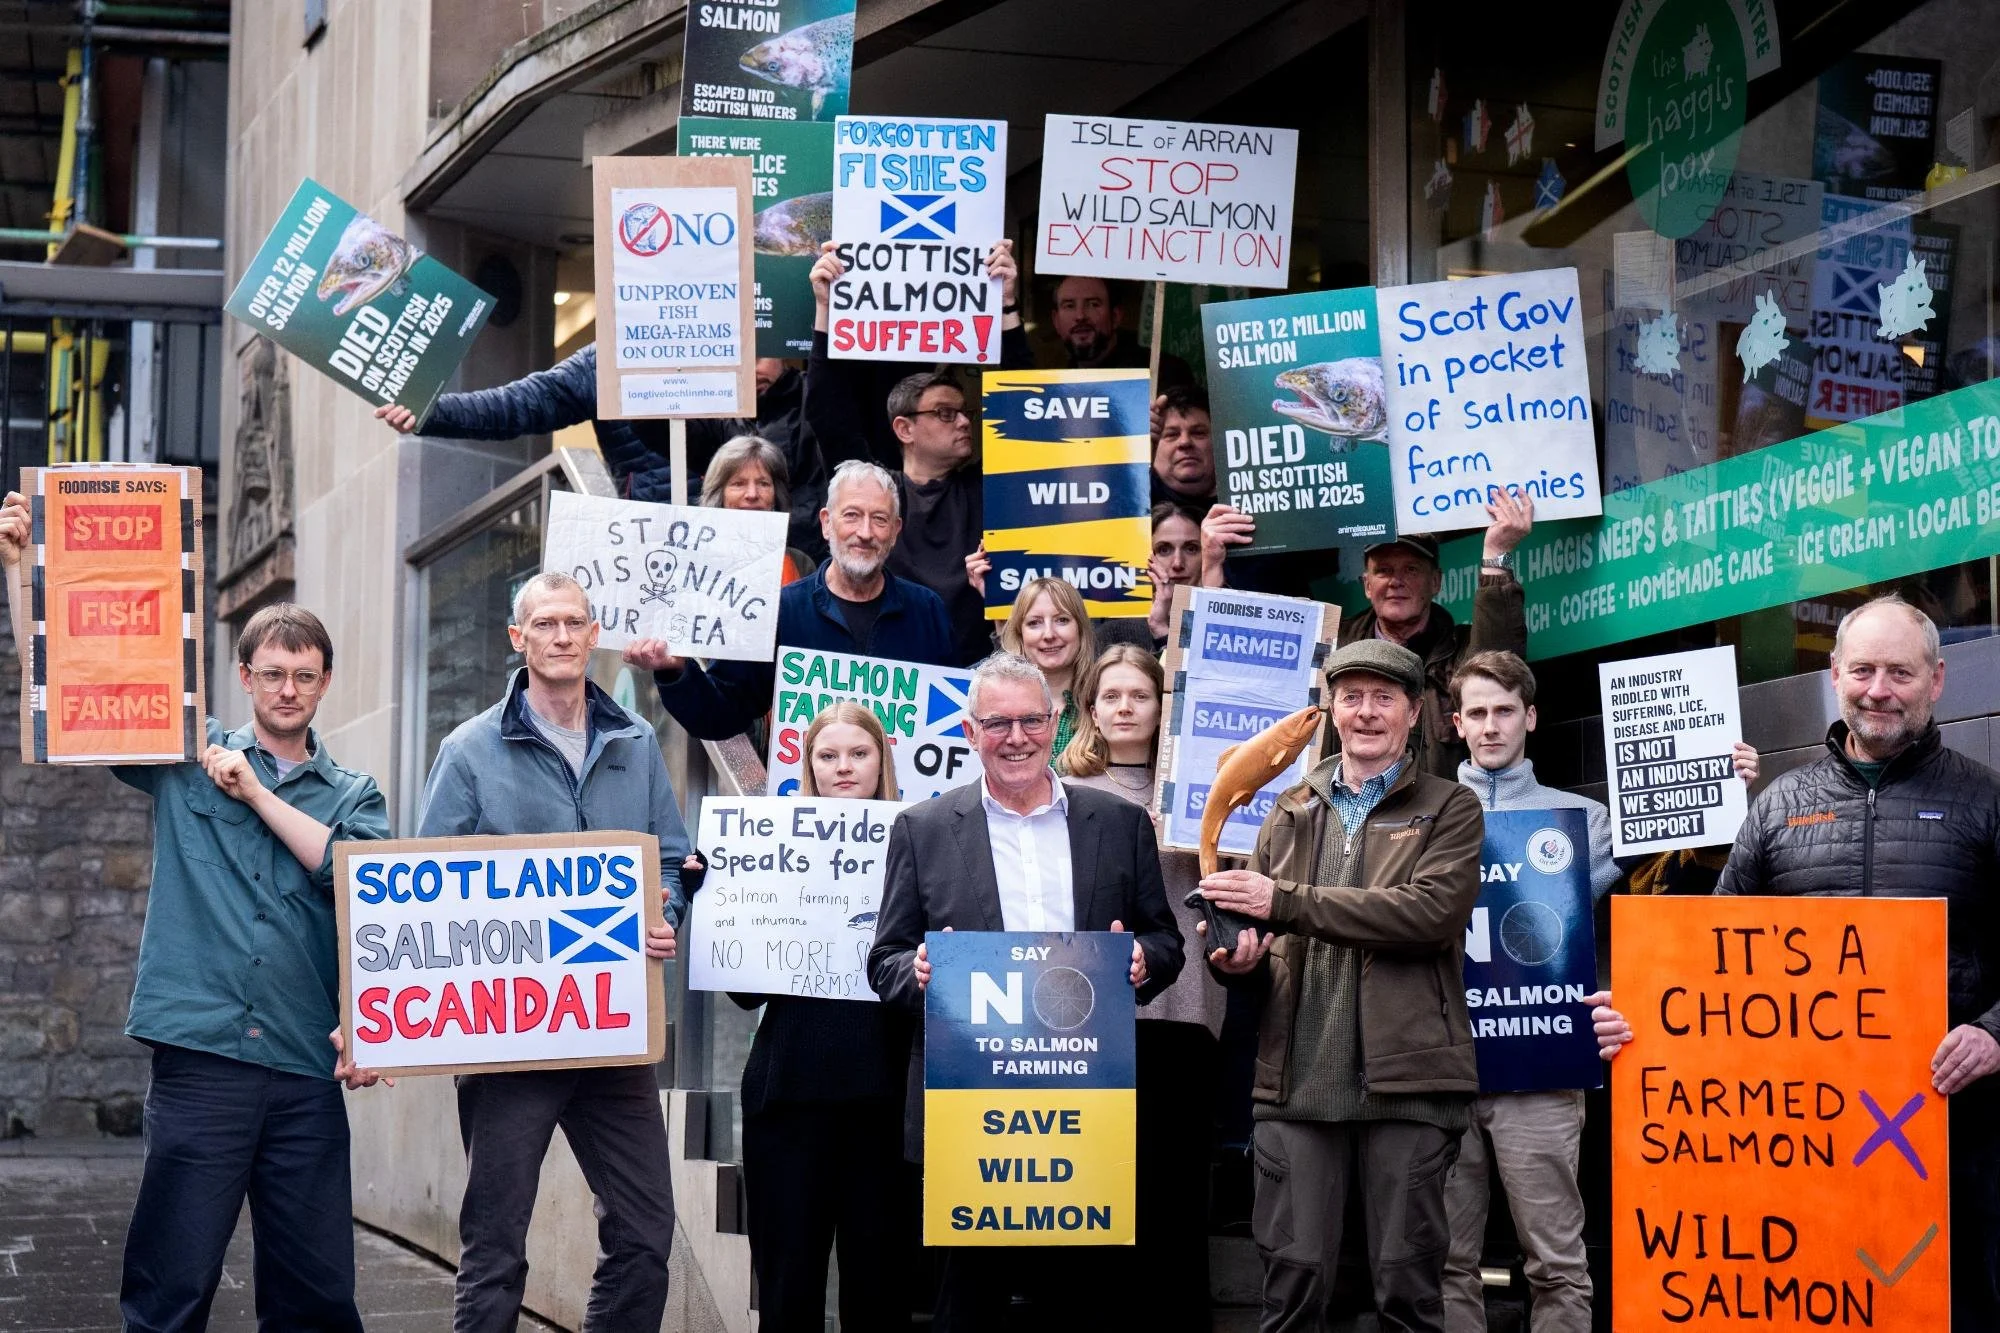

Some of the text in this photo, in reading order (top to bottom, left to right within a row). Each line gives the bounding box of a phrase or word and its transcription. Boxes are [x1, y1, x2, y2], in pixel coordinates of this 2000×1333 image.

[700, 5, 780, 34] SALMON
[1653, 49, 1679, 78] the
[693, 98, 797, 121] SCOTTISH WATERS
[694, 84, 775, 104] ESCAPED INTO
[1645, 65, 1734, 146] haggis
[690, 134, 762, 151] THERE WERE
[837, 120, 996, 152] FORGOTTEN
[1071, 121, 1144, 148] ISLE
[1182, 128, 1273, 155] ARRAN
[839, 153, 987, 193] FISHES
[1099, 157, 1239, 196] STOP
[1660, 146, 1716, 198] box
[1062, 192, 1276, 231] WILD SALMON
[672, 211, 735, 247] NO
[248, 196, 332, 320] OVER 12 MILLION
[1047, 223, 1282, 269] EXTINCTION
[265, 262, 318, 332] SALMON
[619, 283, 737, 302] UNPROVEN
[833, 280, 987, 313] SALMON
[419, 292, 454, 337] 2025
[658, 305, 699, 321] FISH
[1216, 309, 1367, 345] OVER 12 MILLION
[1399, 291, 1574, 343] Scot Gov
[328, 305, 392, 382] DIED
[361, 292, 430, 393] ON SCOTTISH
[407, 331, 432, 355] IN
[626, 322, 732, 341] MEGA-FARMS
[622, 344, 735, 360] ON OUR LOCH
[1218, 340, 1298, 370] SALMON
[1398, 333, 1566, 393] in pocket
[377, 350, 421, 404] FARMS
[662, 377, 688, 386] www.
[1024, 396, 1110, 420] SAVE
[1405, 393, 1588, 432] of salmon
[1224, 423, 1307, 469] DIED
[1228, 461, 1348, 493] ON SCOTTISH
[1408, 445, 1492, 484] farm
[58, 480, 168, 495] FOODRISE SAYS:
[1028, 482, 1111, 505] WILD
[1230, 483, 1365, 515] FARMS IN 2025
[1528, 532, 1594, 584] HAGGIS
[1599, 514, 1658, 564] NEEPS
[1661, 508, 1679, 548] &
[1682, 482, 1764, 542] TATTIES
[1769, 455, 1855, 521] (VEGGIE
[1879, 427, 1962, 485] VEGAN
[73, 515, 154, 542] STOP
[1559, 582, 1616, 626] COFFEE
[1628, 553, 1723, 609] HOMEMADE
[1728, 541, 1774, 585] CAKE
[1798, 527, 1825, 566] ICE
[1829, 514, 1896, 559] CREAM
[1908, 494, 1971, 540] LOCAL
[81, 601, 151, 627] FISH
[1207, 600, 1306, 625] FOODRISE SAYS:
[1205, 630, 1299, 661] FARMED
[782, 651, 919, 701] SALMON
[1610, 668, 1683, 691] AN INDUSTRY
[62, 694, 170, 722] FARMS
[1611, 684, 1690, 707] RIDDLED WITH
[1612, 699, 1708, 723] SUFFERING, LICE,
[779, 690, 918, 738] FANG
[1194, 709, 1279, 733] SALMO
[1613, 713, 1725, 739] DISEASE AND DEATH
[913, 743, 970, 780] OF
[1618, 738, 1673, 764] IS NOT
[1620, 757, 1730, 790] AN INDUSTRY
[1622, 785, 1720, 815] WE SHOULD
[712, 807, 894, 843] The Evide
[1624, 814, 1701, 841] SUPPORT
[710, 843, 875, 881] Speaks for
[355, 853, 638, 905] SCOTLAND'S
[715, 885, 871, 914] Salmon farming is
[715, 914, 808, 928] and inhumane
[355, 919, 544, 973] SALMON
[711, 939, 744, 970] NO
[765, 939, 838, 975] MORE
[1010, 946, 1052, 961] SAY
[1711, 924, 1867, 977] IT'S A
[791, 973, 860, 997] FARMS!
[1466, 983, 1585, 1008] SALMON
[356, 971, 631, 1044] SCANDAL
[1660, 986, 1892, 1042] CHOICE
[1469, 1014, 1573, 1038] RMING
[975, 1037, 1098, 1052] TO SALMON
[992, 1060, 1088, 1075] FARMING
[1640, 1065, 1846, 1121] FARMED
[983, 1109, 1081, 1135] SAVE
[1640, 1122, 1835, 1168] SALMON
[978, 1158, 1074, 1183] WILD
[951, 1205, 1111, 1231] SALMON
[1635, 1207, 1799, 1264] WILD
[1660, 1271, 1875, 1327] SALMON
